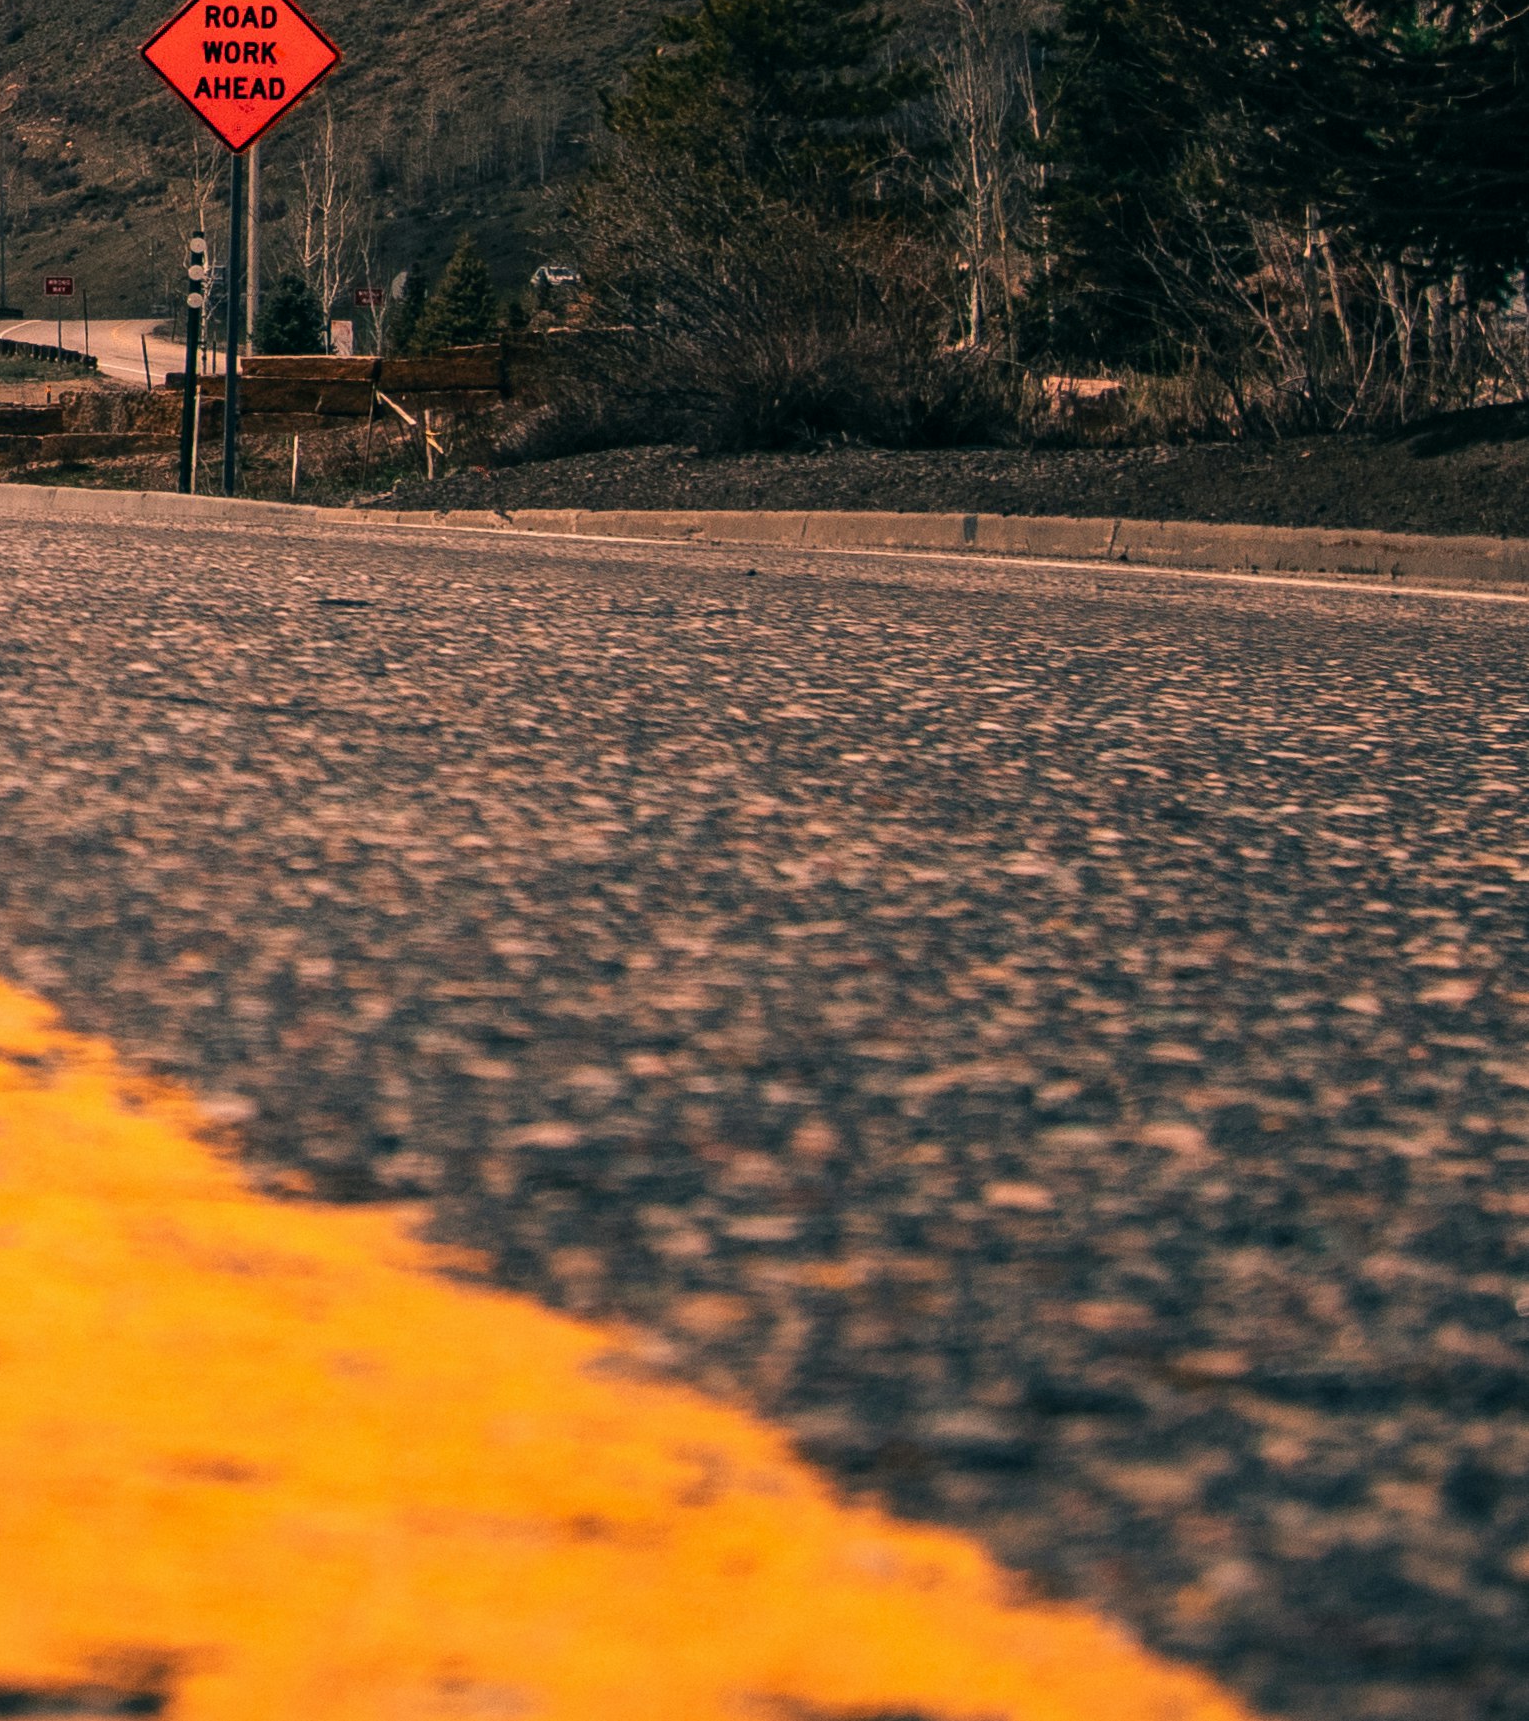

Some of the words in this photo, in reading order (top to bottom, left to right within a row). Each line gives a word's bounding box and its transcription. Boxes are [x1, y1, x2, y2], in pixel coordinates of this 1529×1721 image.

[204, 5, 278, 29] ROAD
[202, 40, 278, 64] WORK
[193, 76, 286, 100] AHEAD
